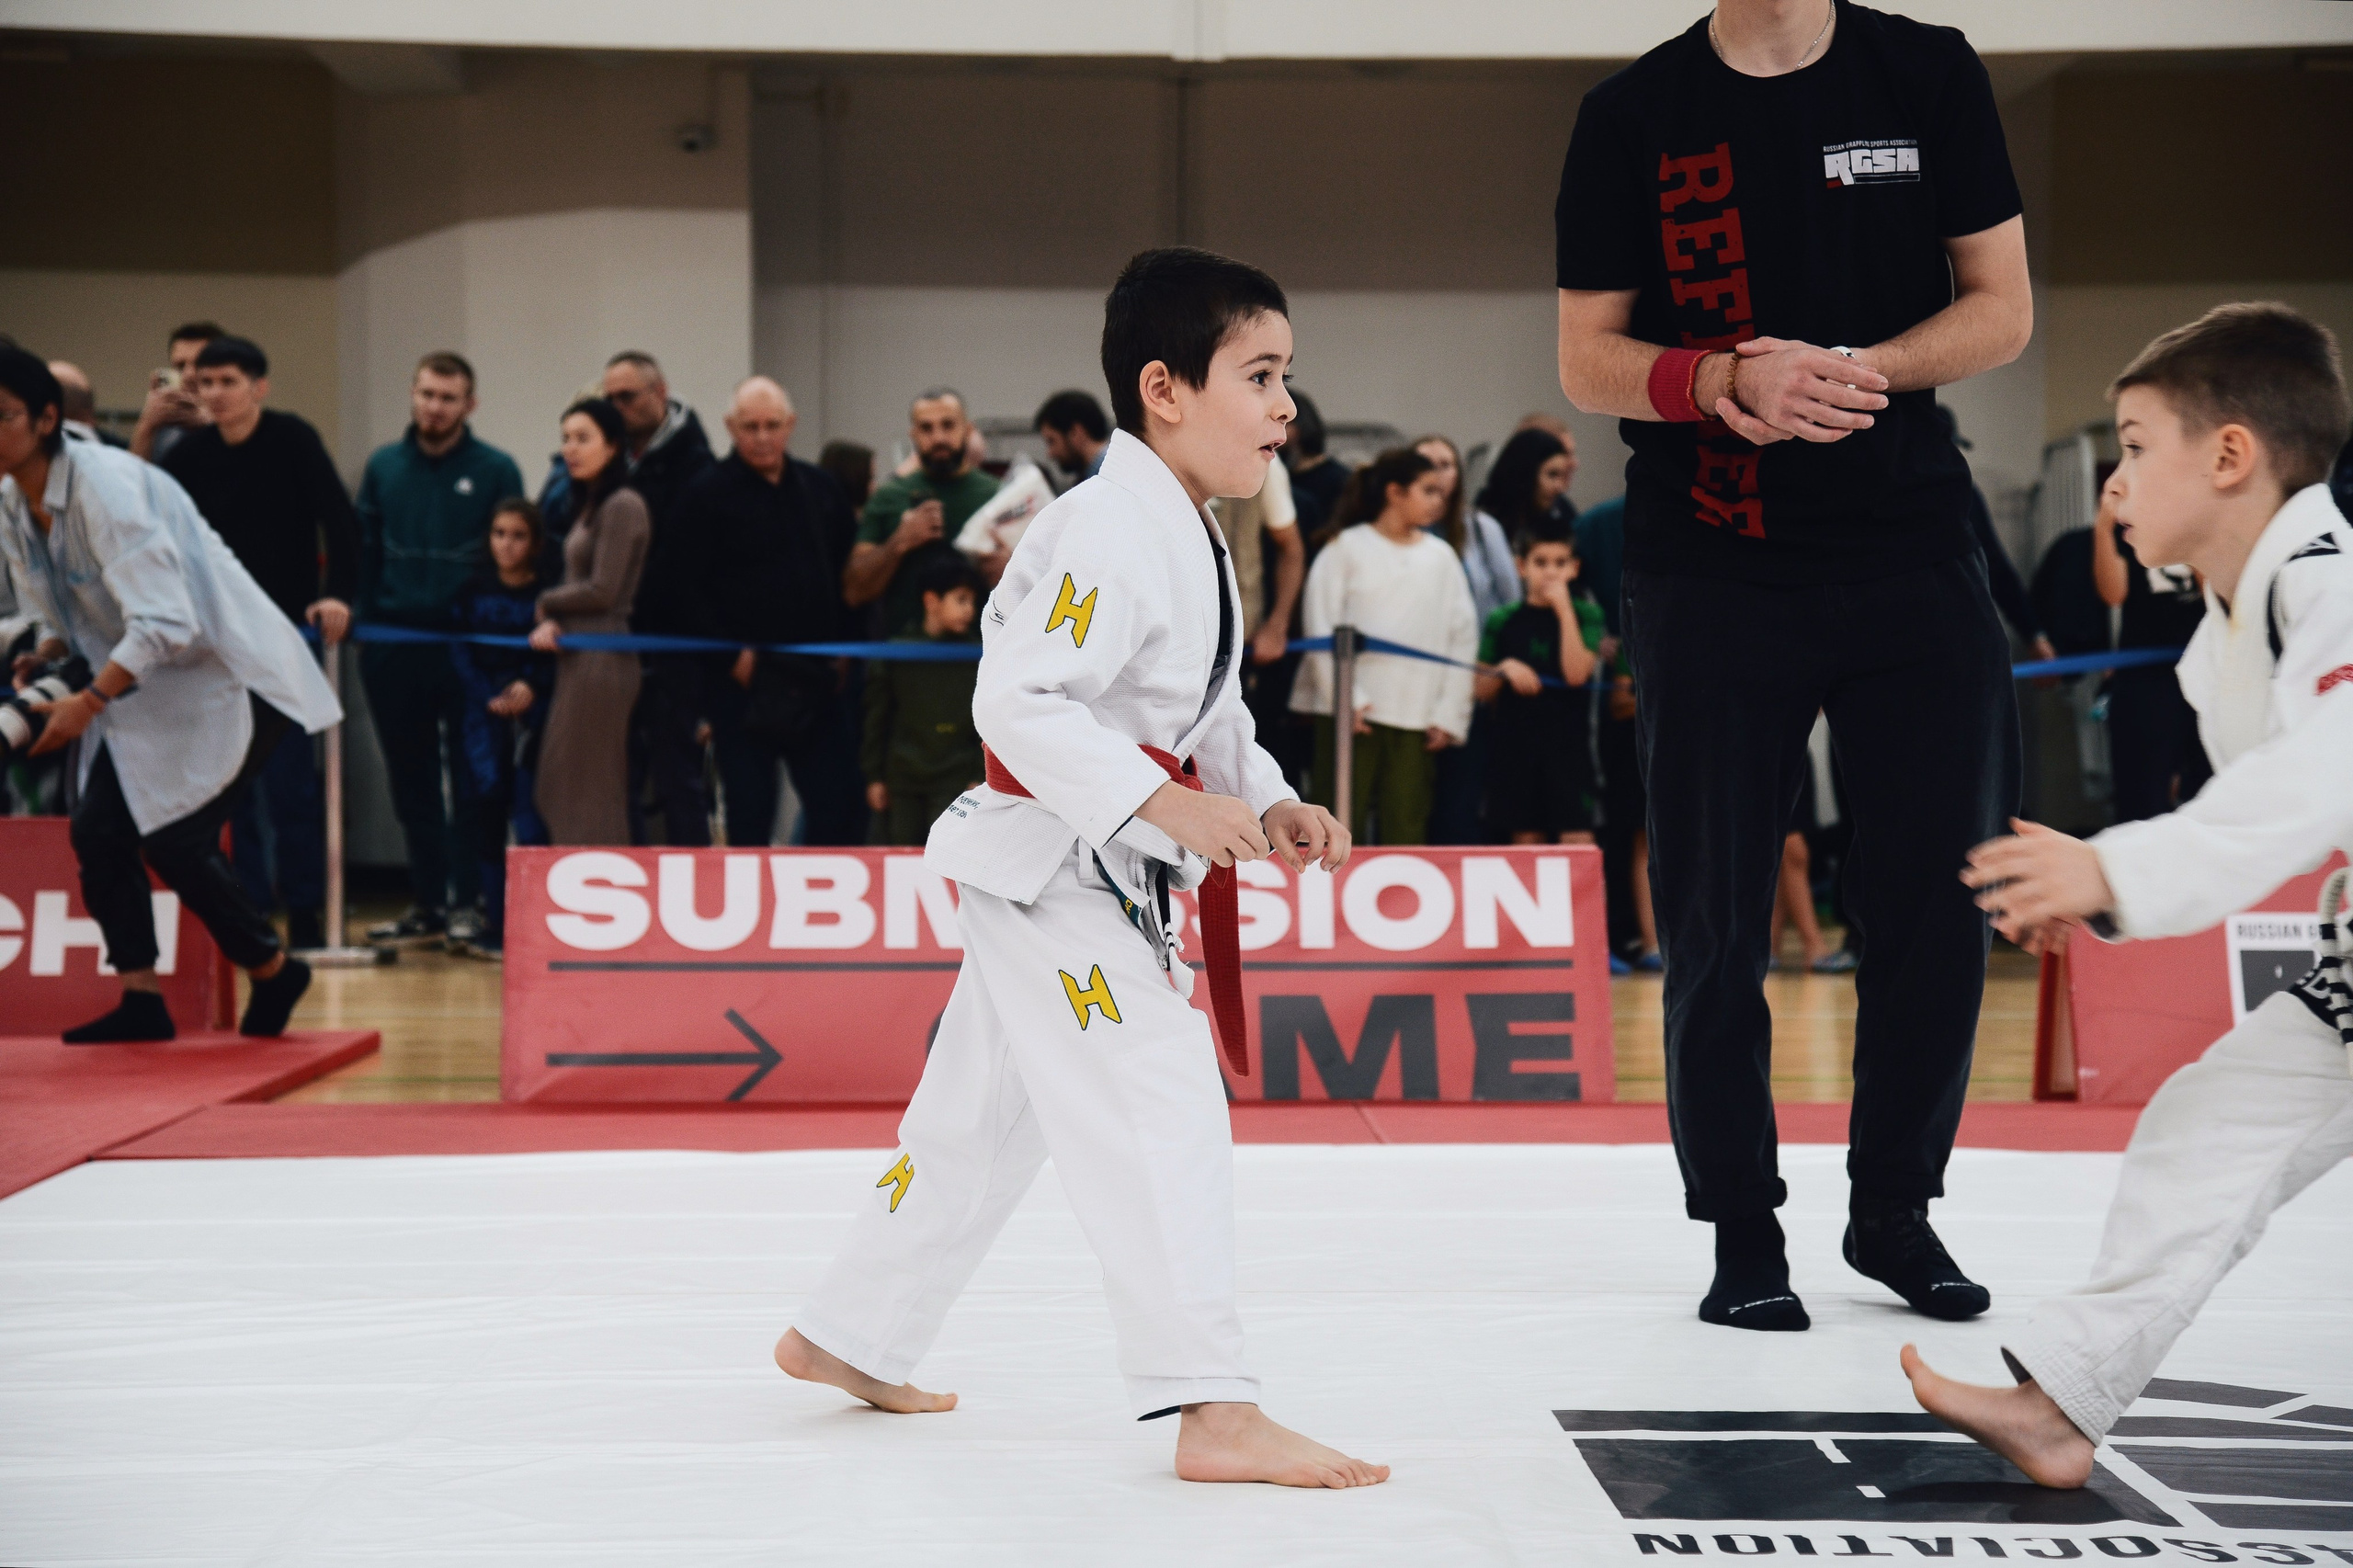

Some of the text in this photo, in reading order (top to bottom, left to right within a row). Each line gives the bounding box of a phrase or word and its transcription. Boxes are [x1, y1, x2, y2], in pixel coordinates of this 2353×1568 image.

[1823, 143, 1846, 153] RUSSIAN
[1870, 140, 1889, 148] SPORTS
[1658, 142, 1767, 540] REFEE
[546, 850, 1574, 951] SUBSION
